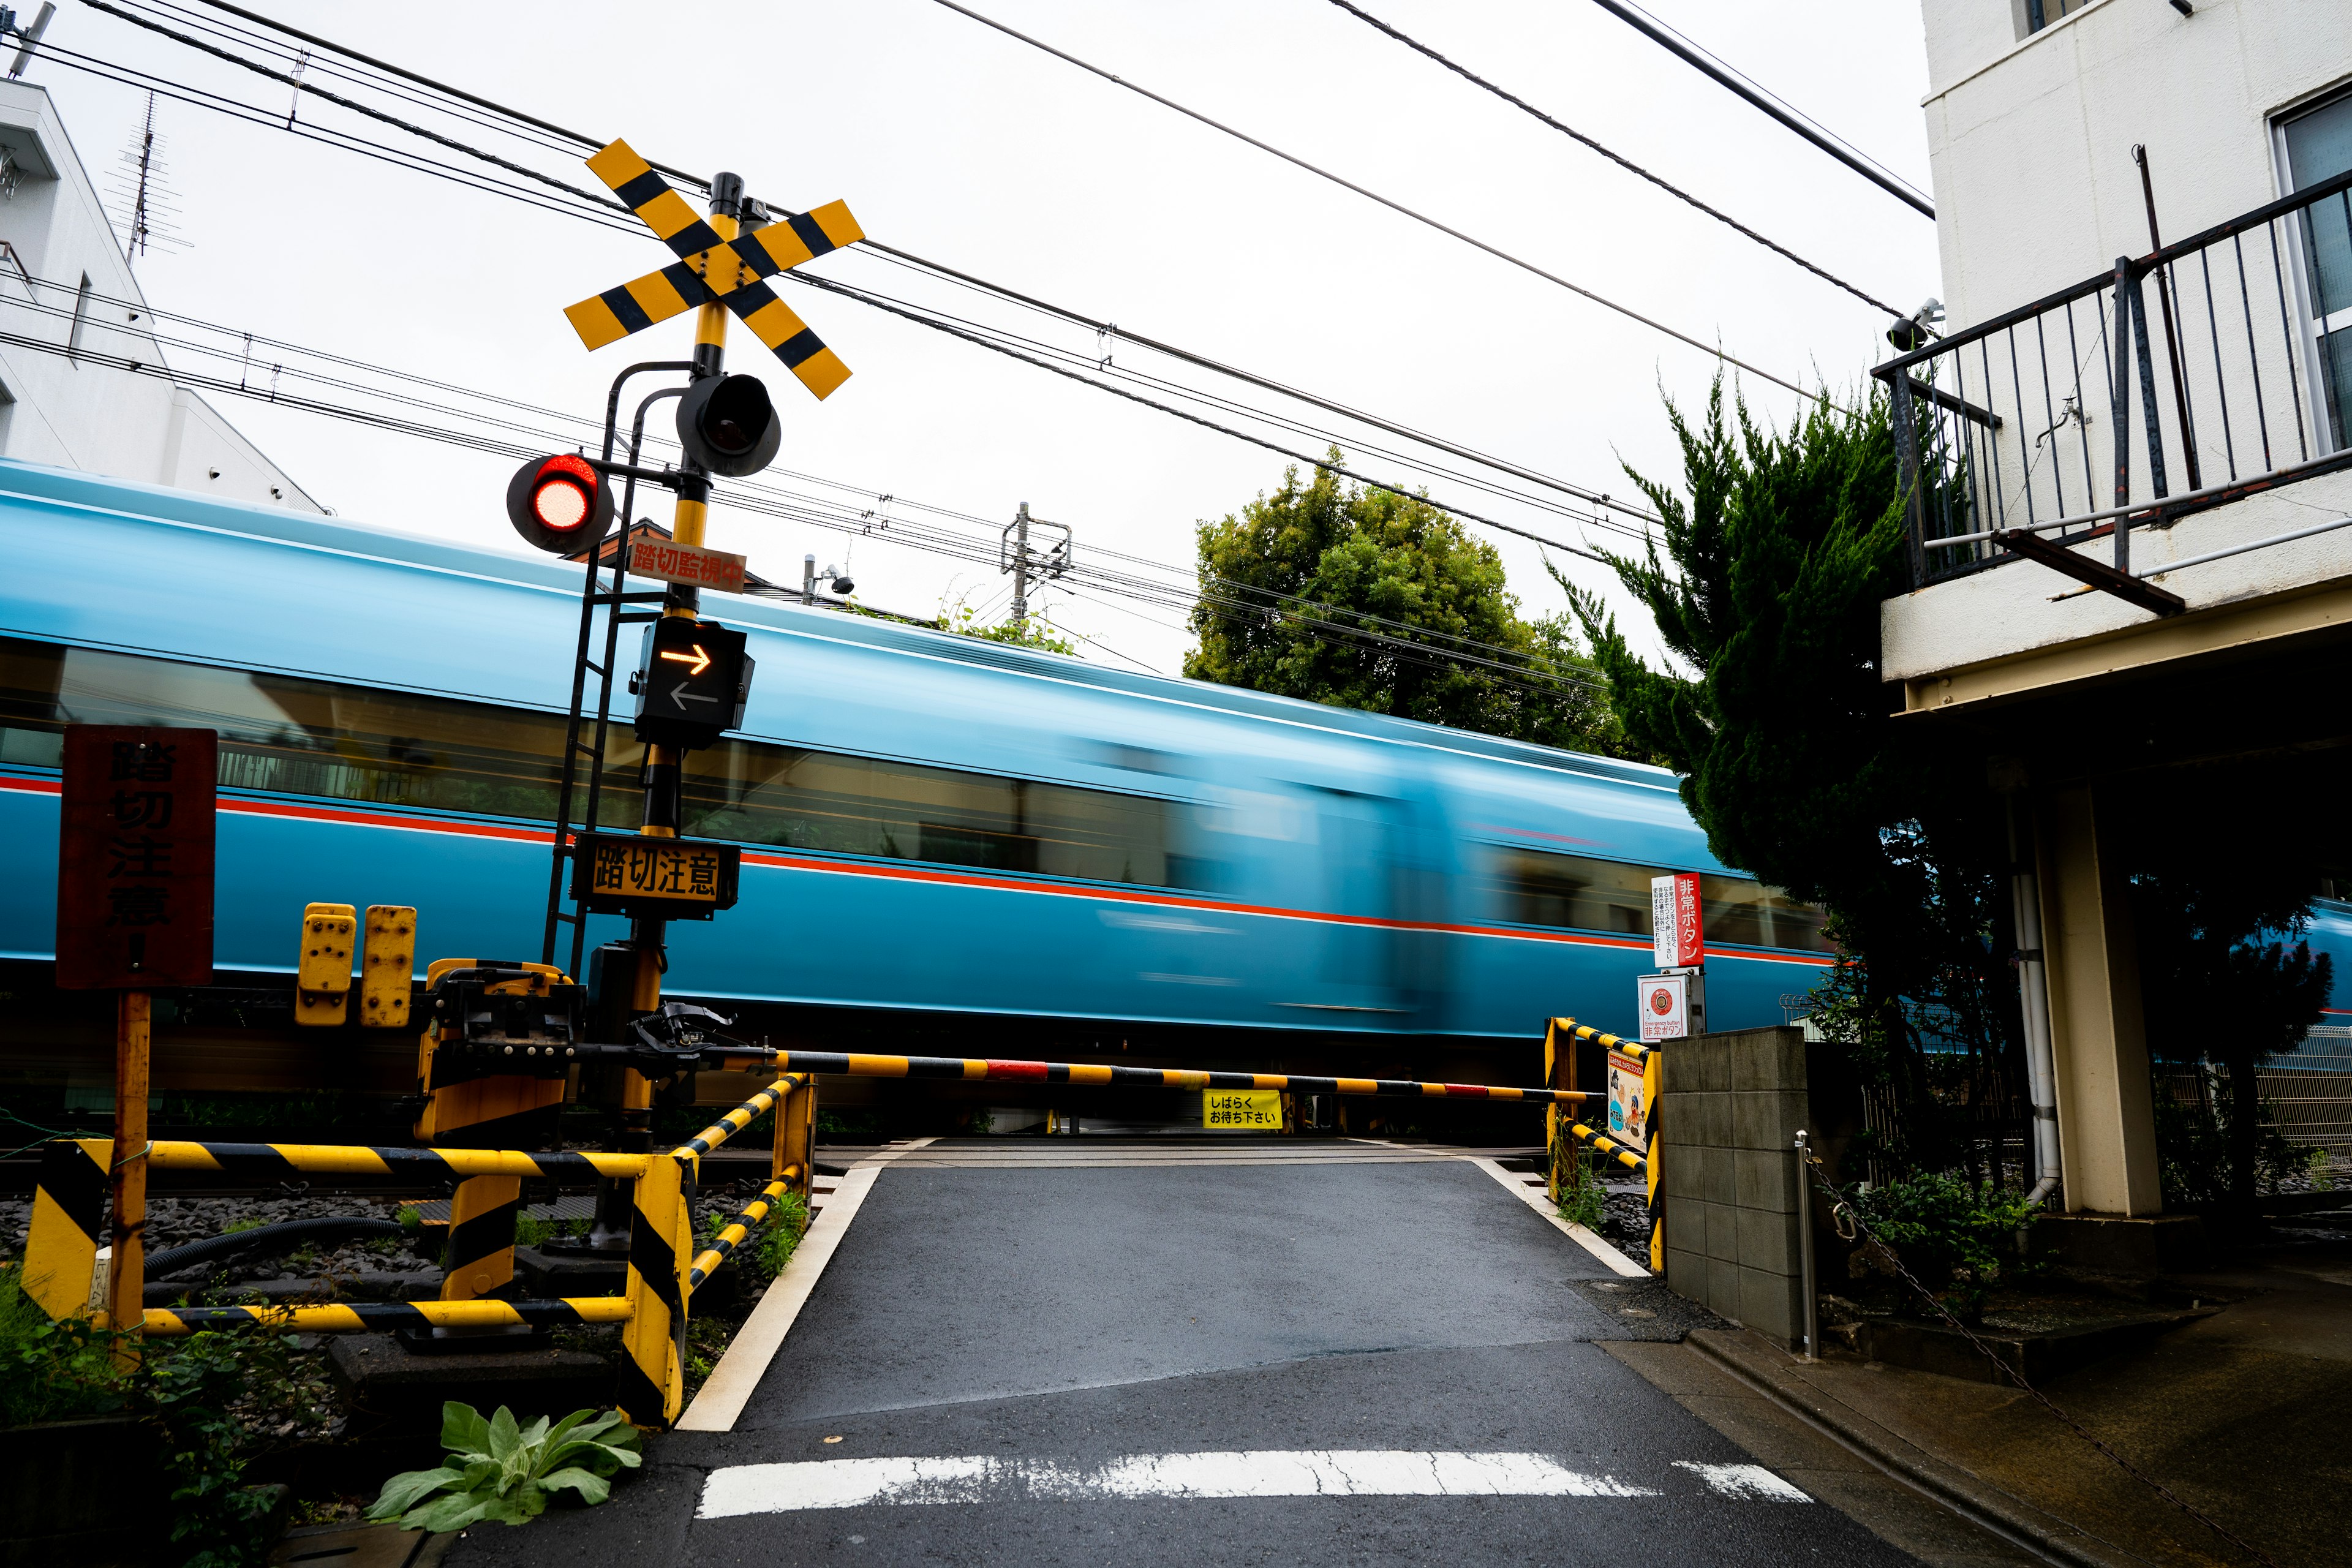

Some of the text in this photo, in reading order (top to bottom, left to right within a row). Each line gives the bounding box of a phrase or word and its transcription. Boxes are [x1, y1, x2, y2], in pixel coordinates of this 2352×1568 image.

[633, 543, 742, 586] 踏切監視中
[595, 845, 717, 895] 踏切注意
[1680, 879, 1697, 959] 非常ボタン
[1645, 1026, 1681, 1036] 非常ボタン
[1210, 1110, 1276, 1123] お待ち下さい
[1212, 1096, 1252, 1109] しばらく
